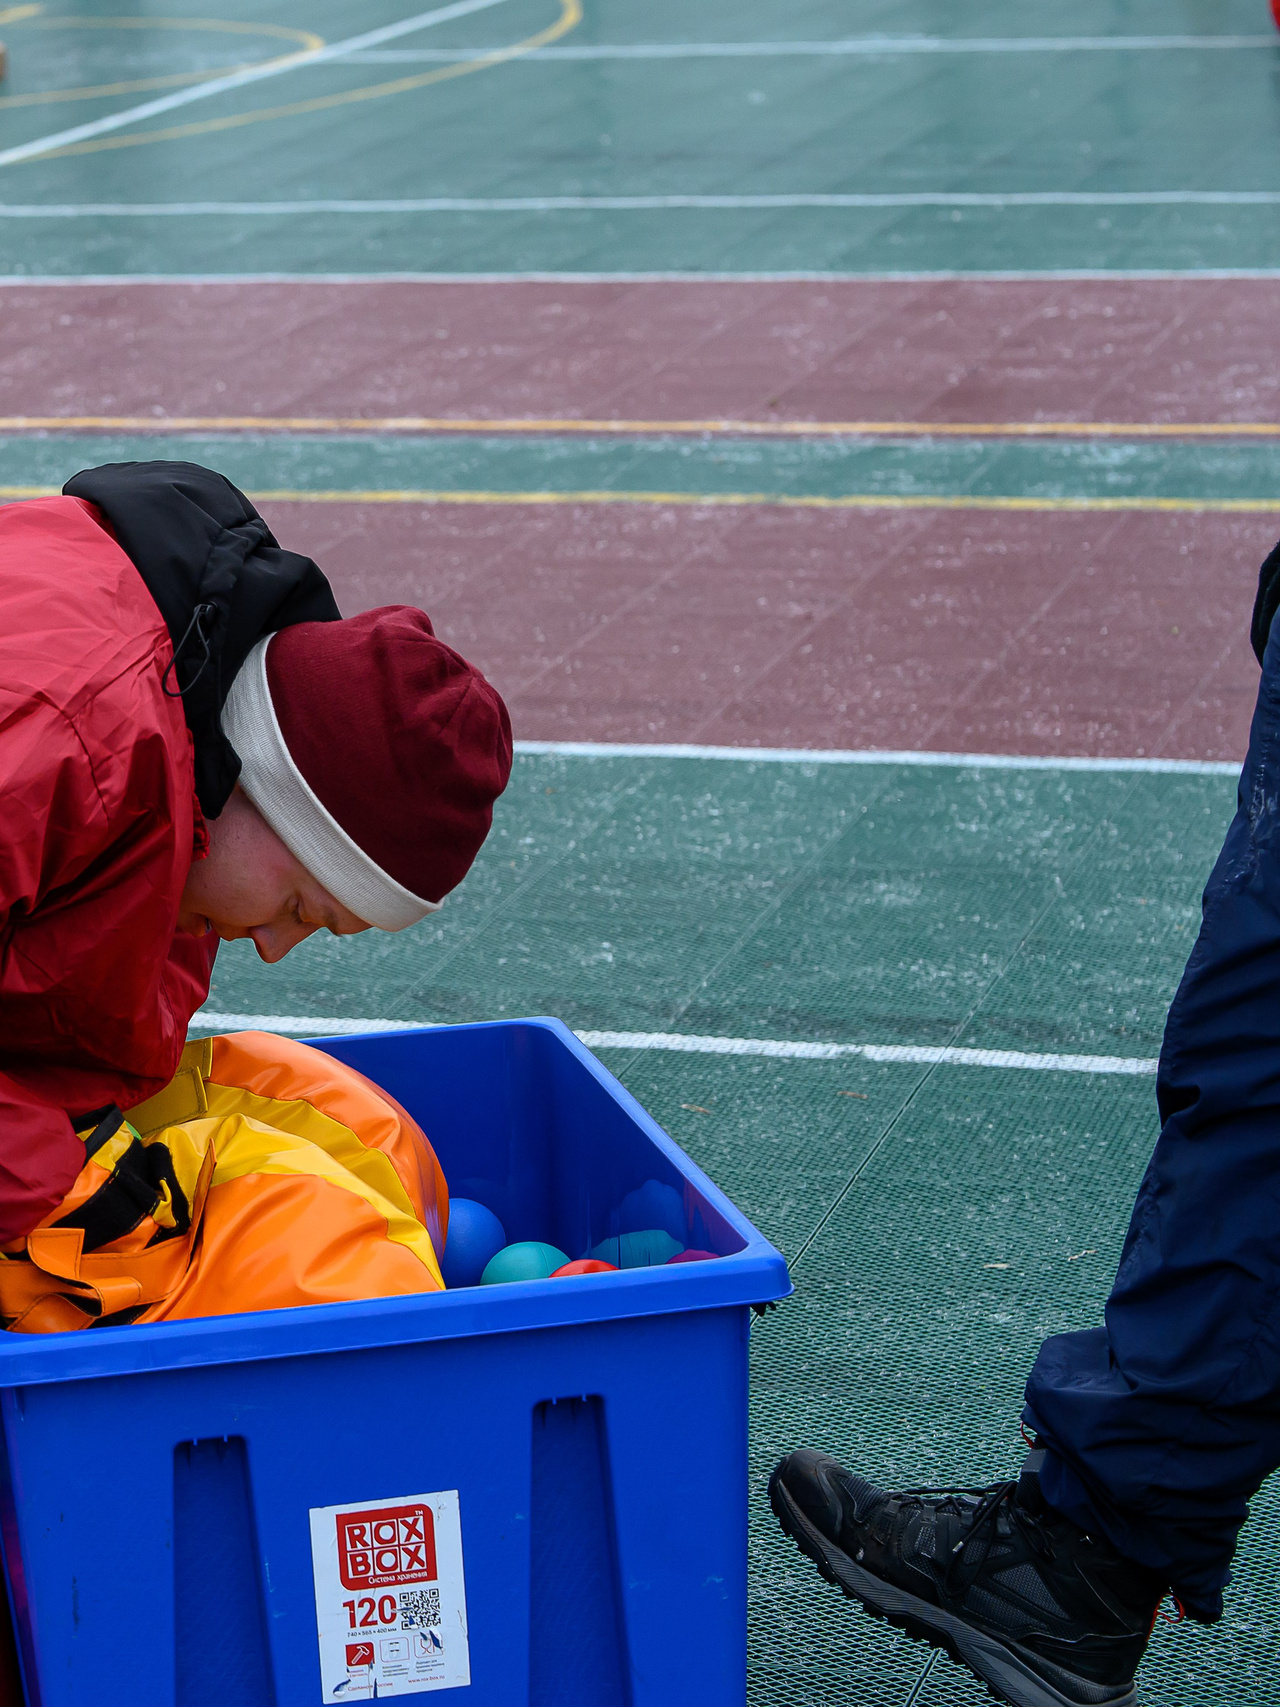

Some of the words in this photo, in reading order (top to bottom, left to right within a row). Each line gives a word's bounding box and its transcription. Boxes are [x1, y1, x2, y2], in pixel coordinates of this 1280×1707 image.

[346, 1517, 424, 1549] ROX
[348, 1545, 426, 1577] BOX
[368, 1575, 396, 1584] Система
[397, 1571, 428, 1581] хранения
[342, 1594, 397, 1629] 120
